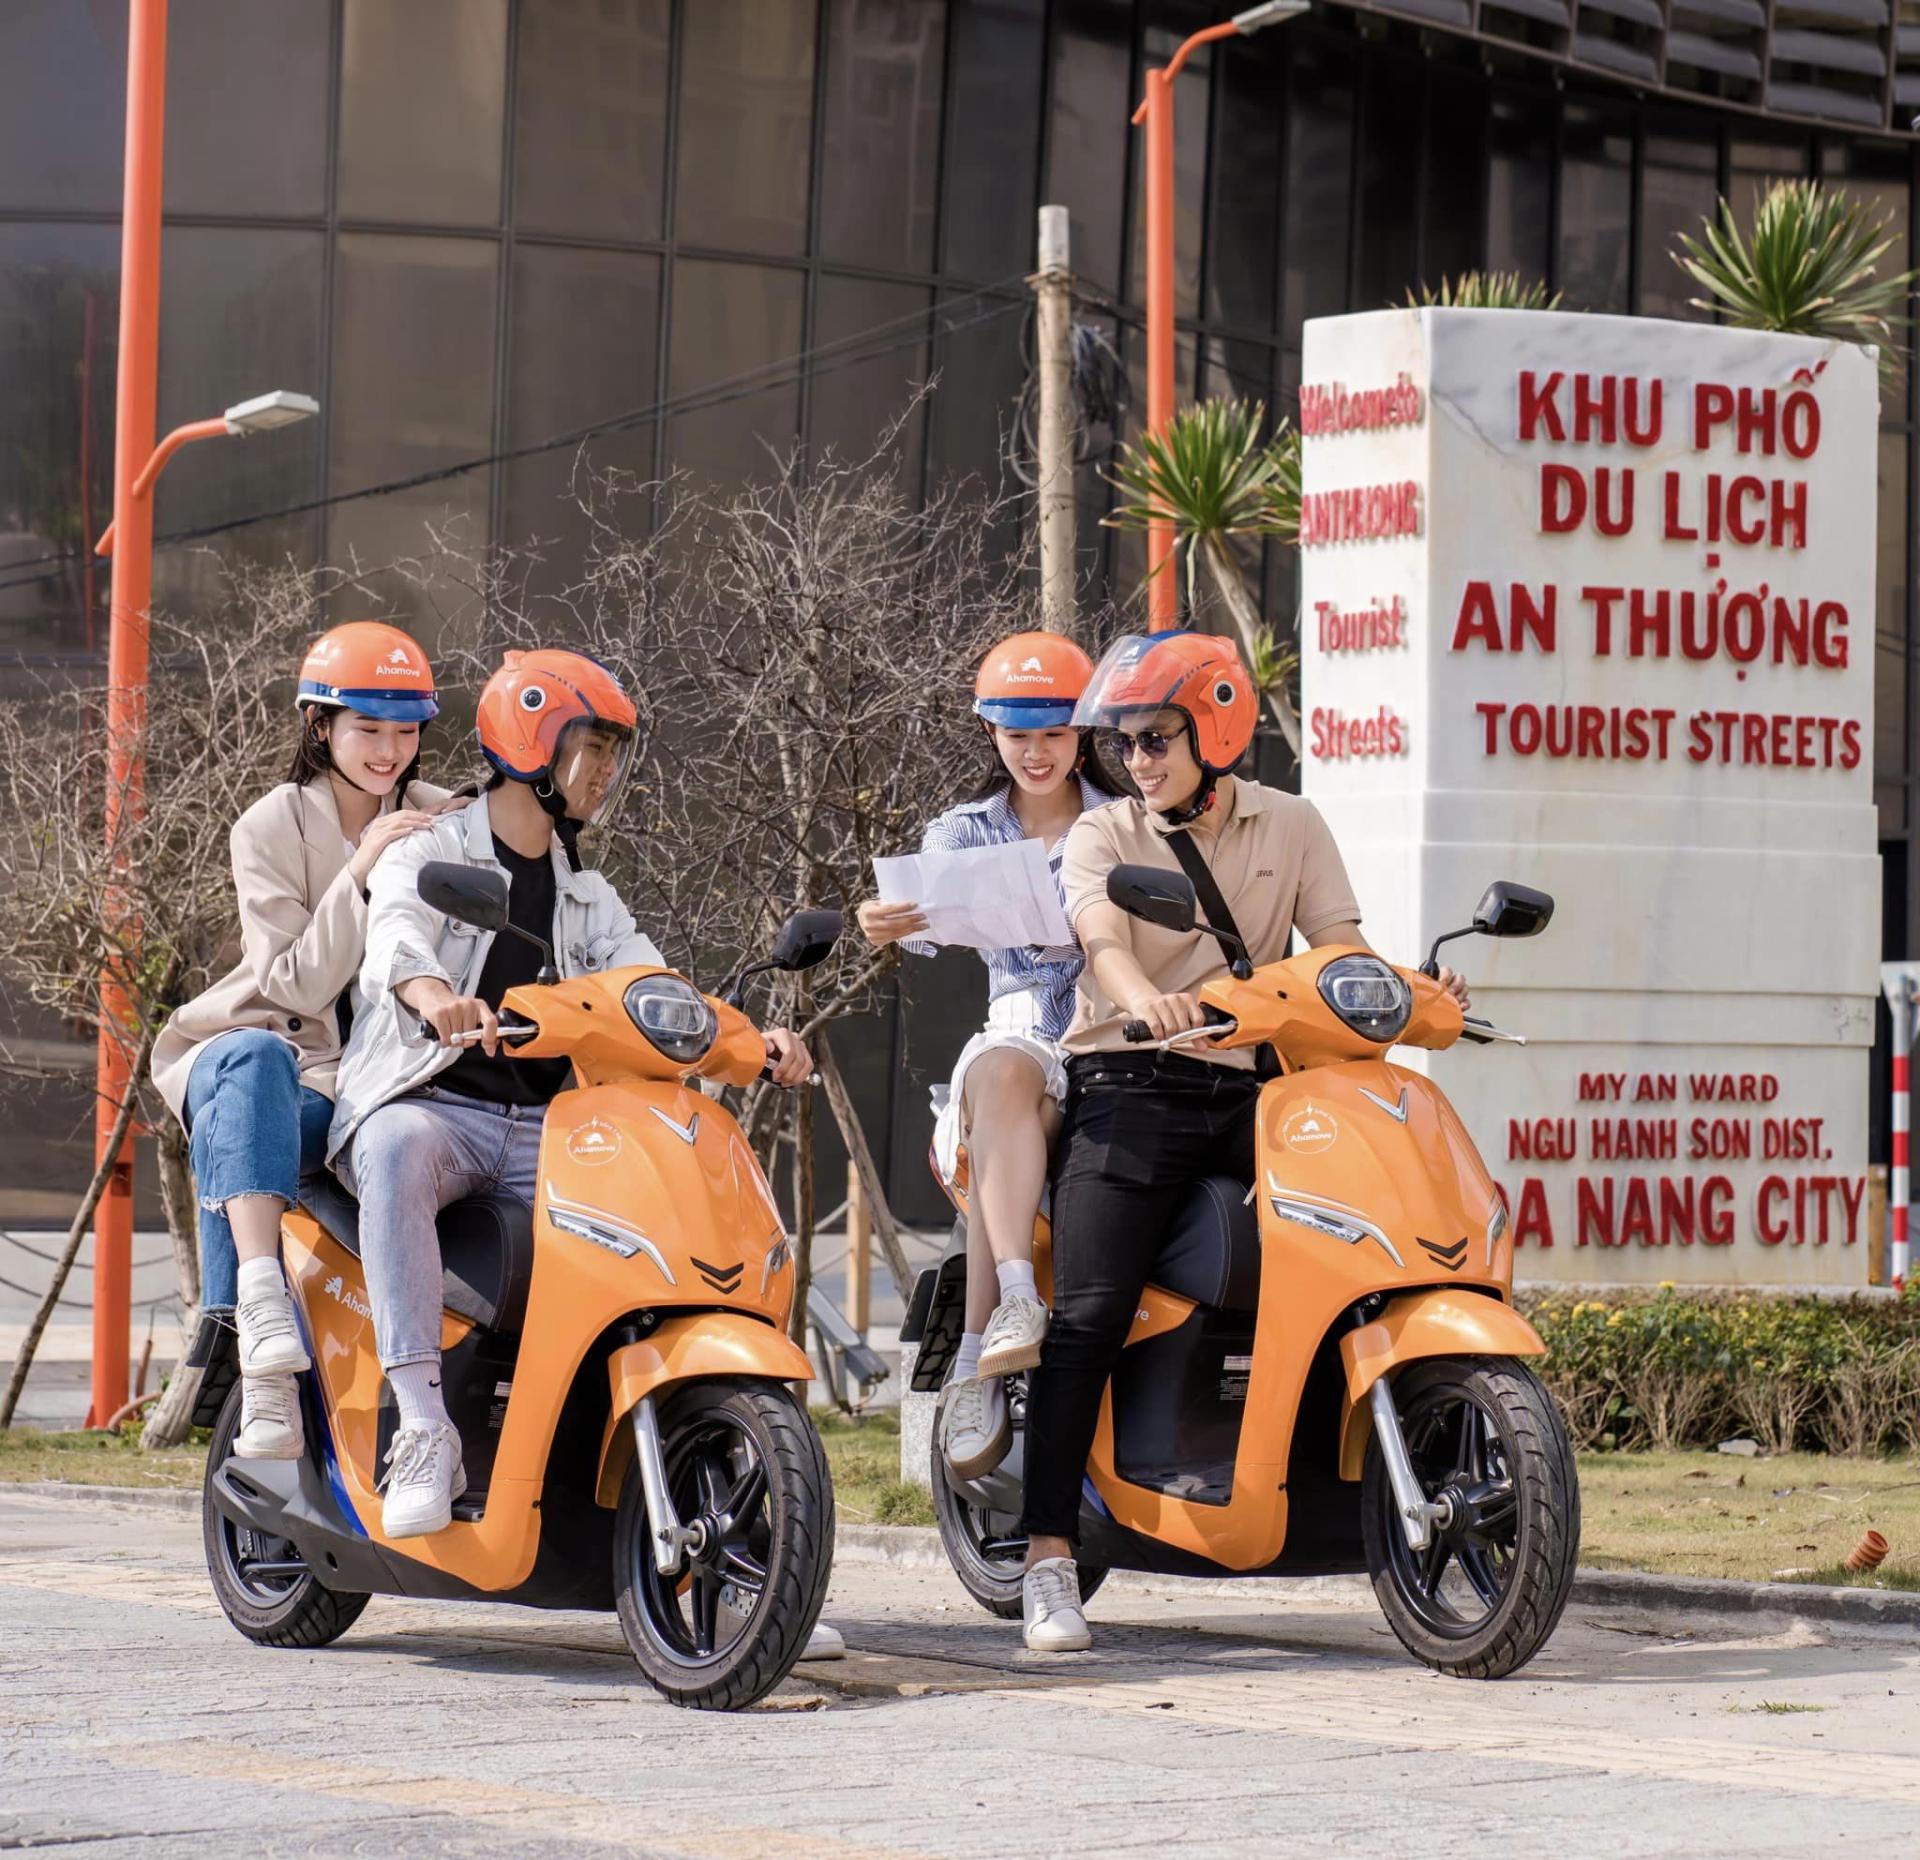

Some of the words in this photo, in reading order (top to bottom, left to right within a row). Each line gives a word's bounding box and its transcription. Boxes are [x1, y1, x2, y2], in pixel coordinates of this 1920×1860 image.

[1519, 371, 1664, 448] KHU
[1694, 361, 1828, 459] PHỐ
[1540, 463, 1635, 538] DU
[1664, 471, 1808, 569] LỊCH
[1314, 594, 1402, 652] Tourist
[1452, 581, 1558, 653] AN
[1582, 578, 1849, 681] THƯỢNG
[1006, 674, 1054, 684] Ahamove
[1311, 706, 1402, 758] Streets
[1476, 703, 1676, 760] TOURIST
[1687, 711, 1861, 769] STREETS
[1578, 1073, 1627, 1101] MY
[1633, 1073, 1677, 1101] AN
[1690, 1073, 1779, 1101] WARD
[1508, 1117, 1576, 1161] NGU
[1591, 1118, 1678, 1161] HANH
[1690, 1117, 1751, 1160] SON
[1763, 1117, 1833, 1161] DIST.
[1576, 1175, 1736, 1247] NANG
[1756, 1175, 1867, 1246] CITY
[341, 1291, 374, 1321] Aham
